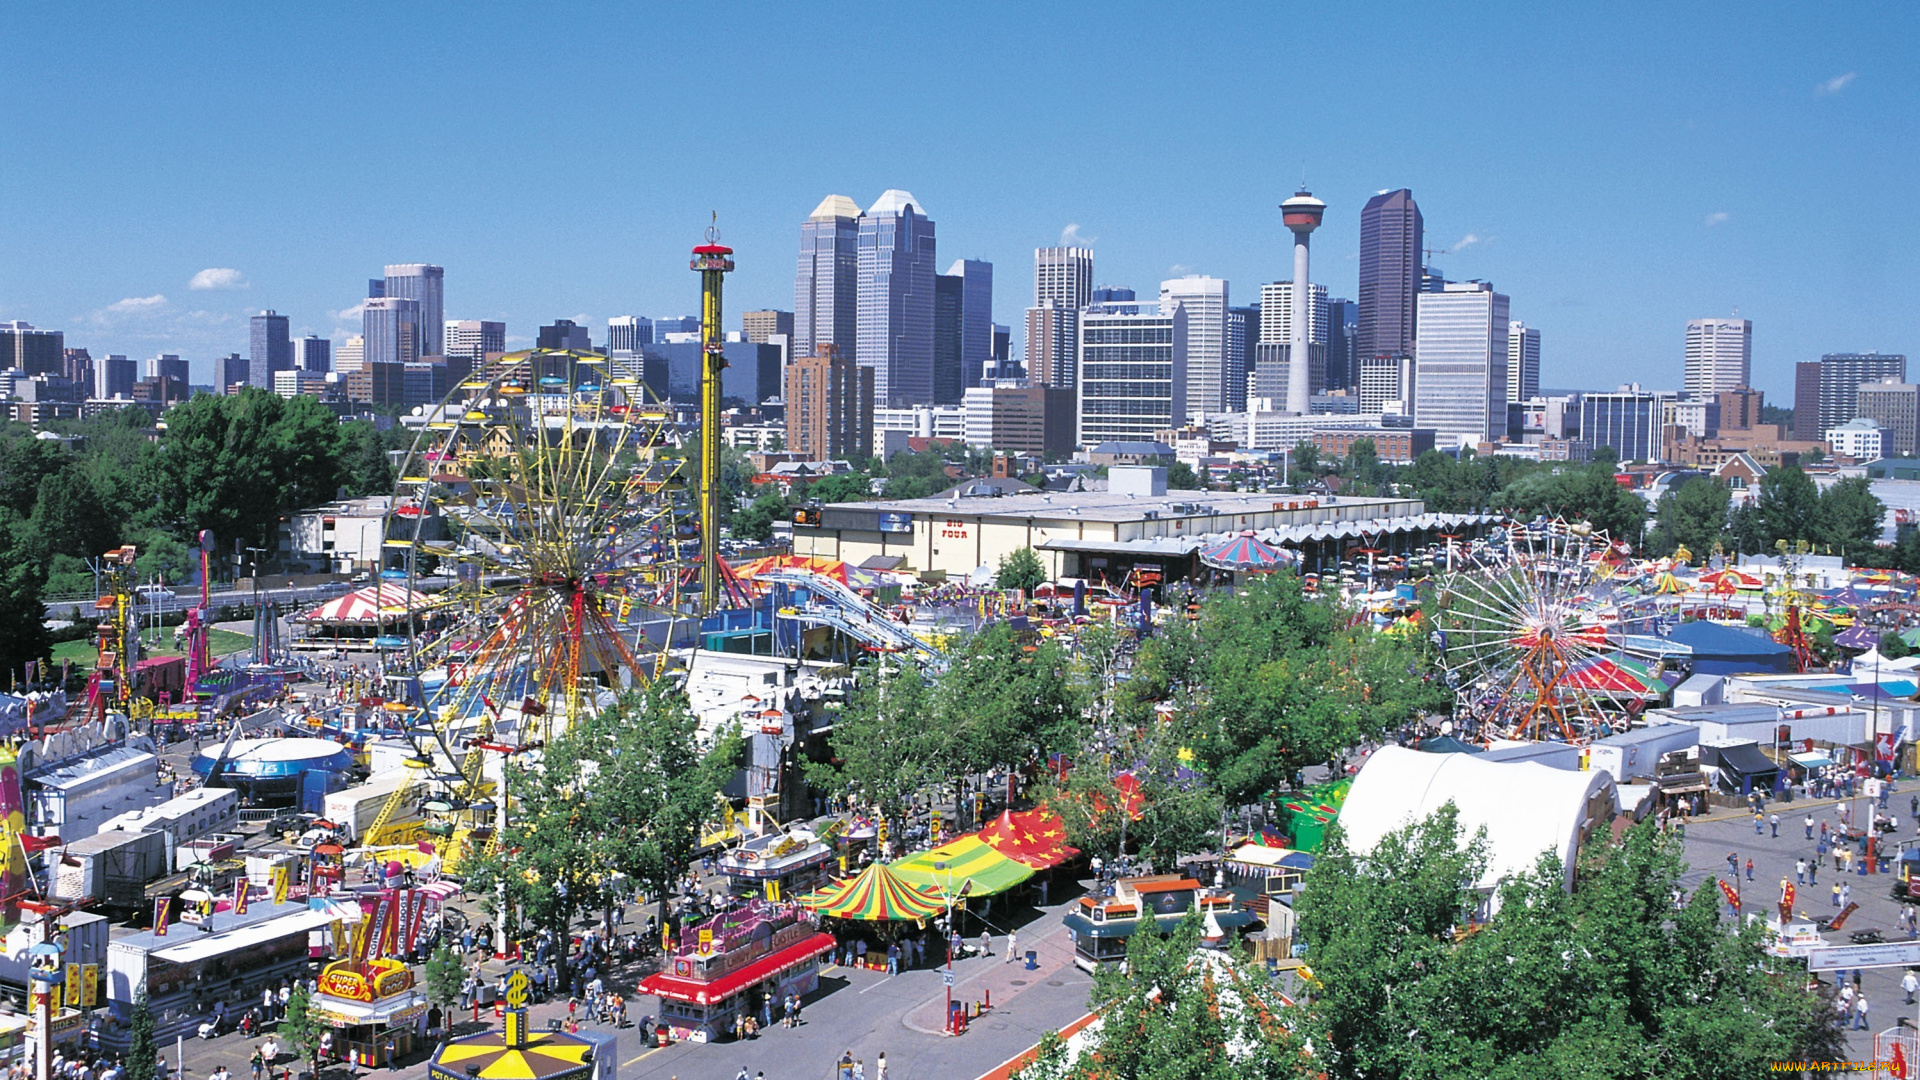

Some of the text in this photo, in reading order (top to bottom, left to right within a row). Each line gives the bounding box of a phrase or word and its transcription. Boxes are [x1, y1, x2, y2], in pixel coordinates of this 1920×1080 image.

[946, 519, 964, 528] BIG
[941, 530, 968, 539] FOUR
[398, 895, 408, 950] CORN DOGS
[329, 974, 359, 988] SUPER
[944, 975, 954, 984] 30
[334, 983, 356, 995] DOG
[384, 980, 404, 995] DOG
[431, 1069, 444, 1080] POT
